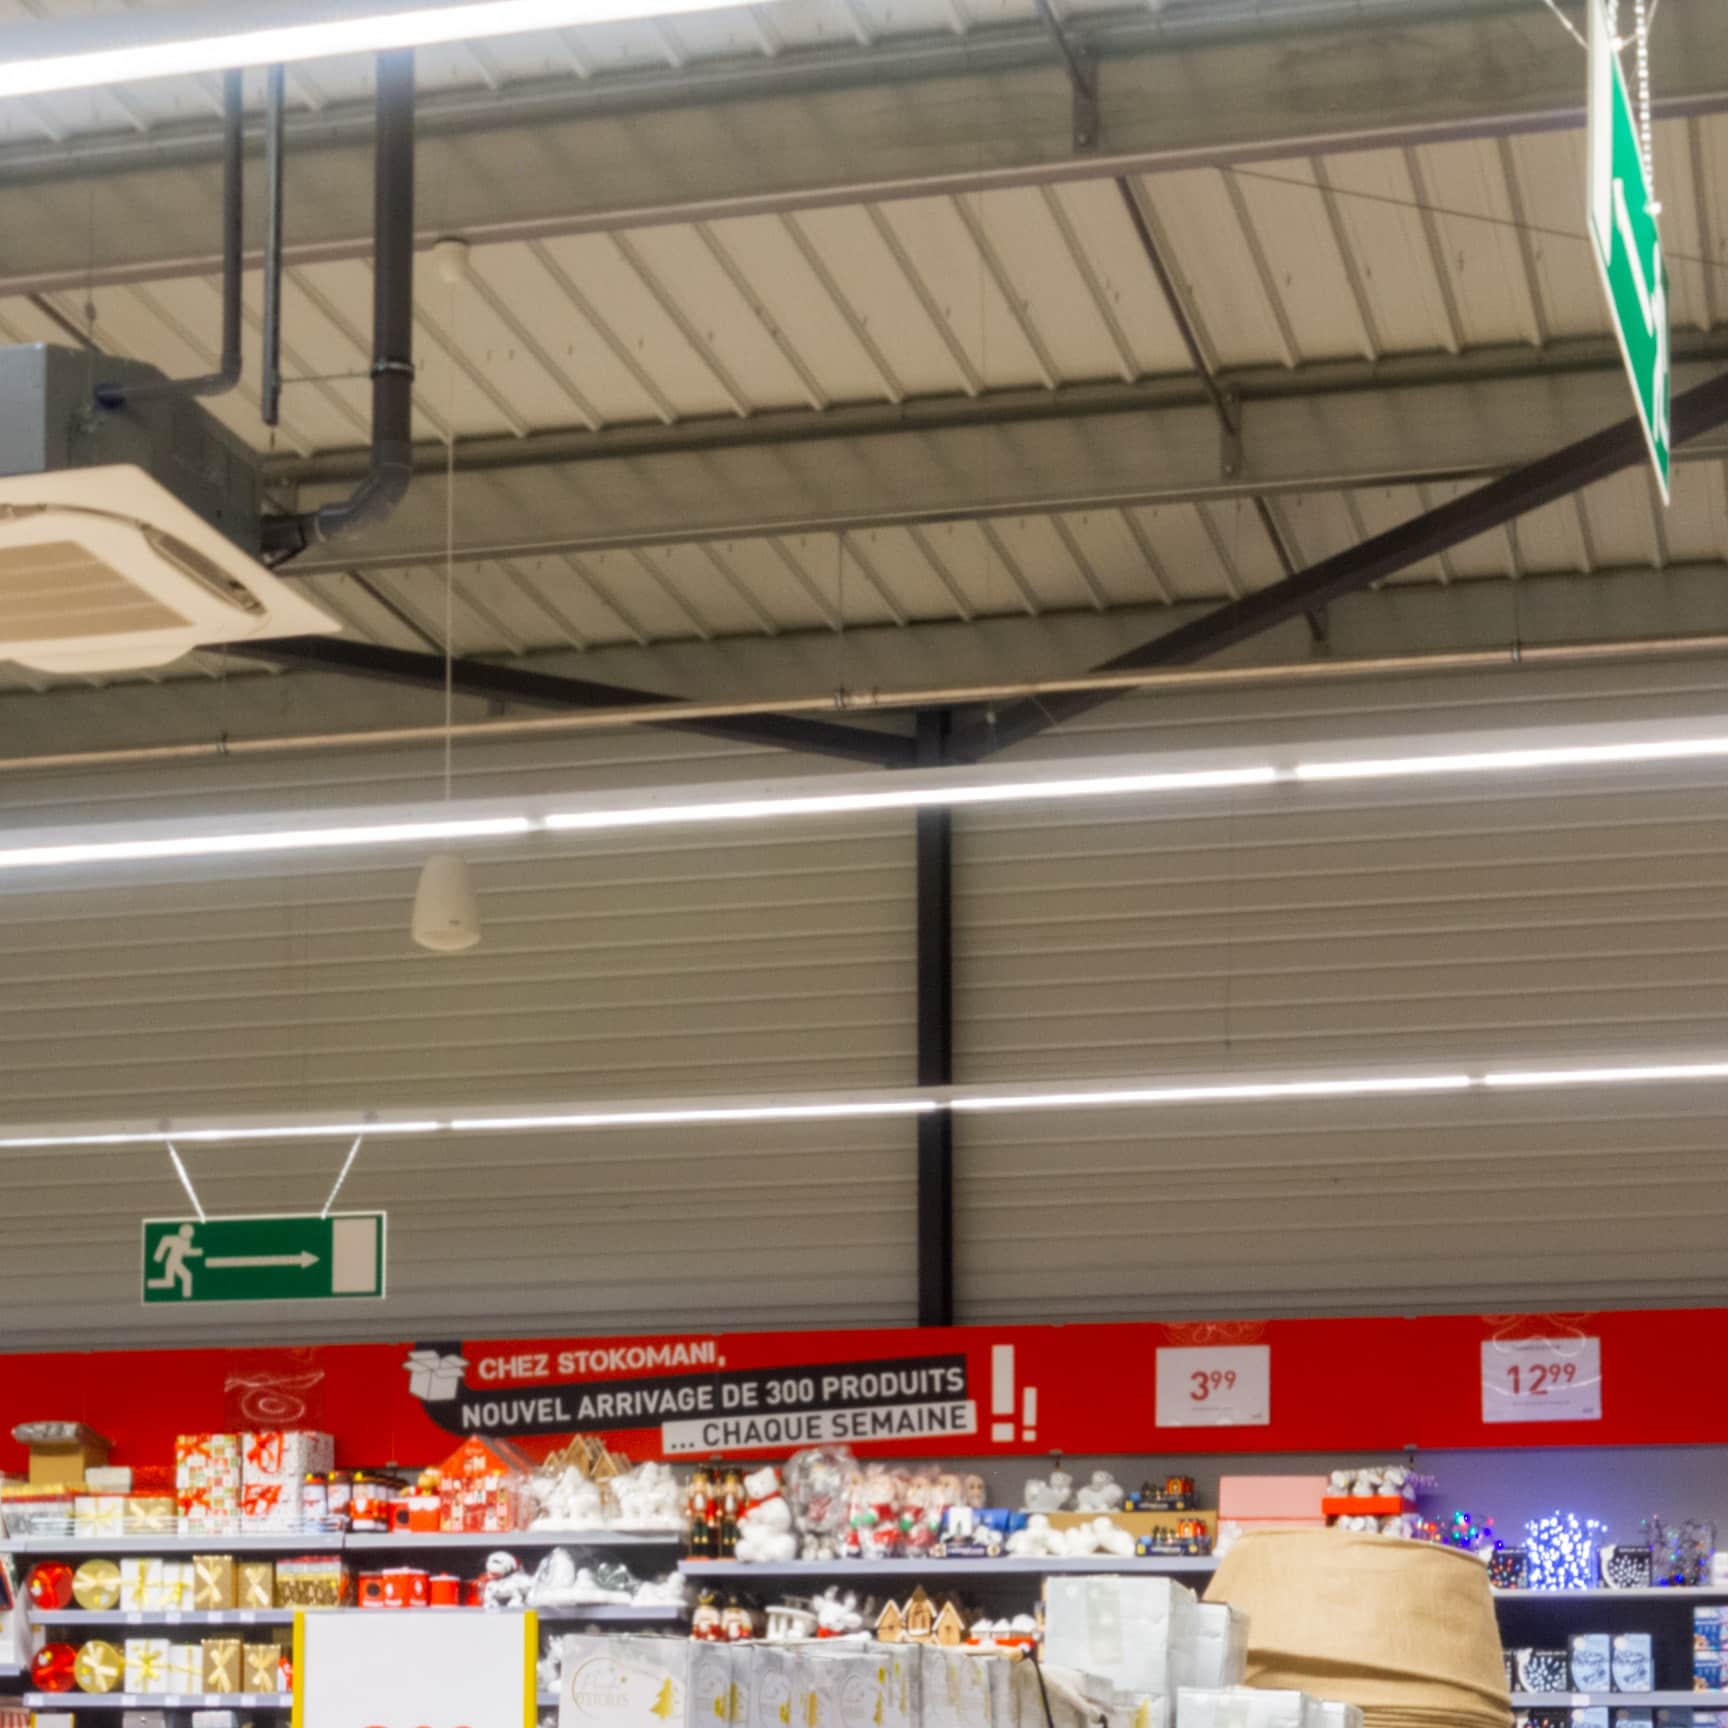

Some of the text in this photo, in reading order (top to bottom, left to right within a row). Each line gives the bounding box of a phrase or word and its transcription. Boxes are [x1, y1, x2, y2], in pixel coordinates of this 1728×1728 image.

[478, 1341, 726, 1380] CHEZ STOKOMANI,
[462, 1367, 965, 1428] NOUVEL ARRIVAGE DE 300 PRODUITS
[702, 1415, 823, 1447] CHAQUE
[832, 1404, 968, 1437] SEMAINE
